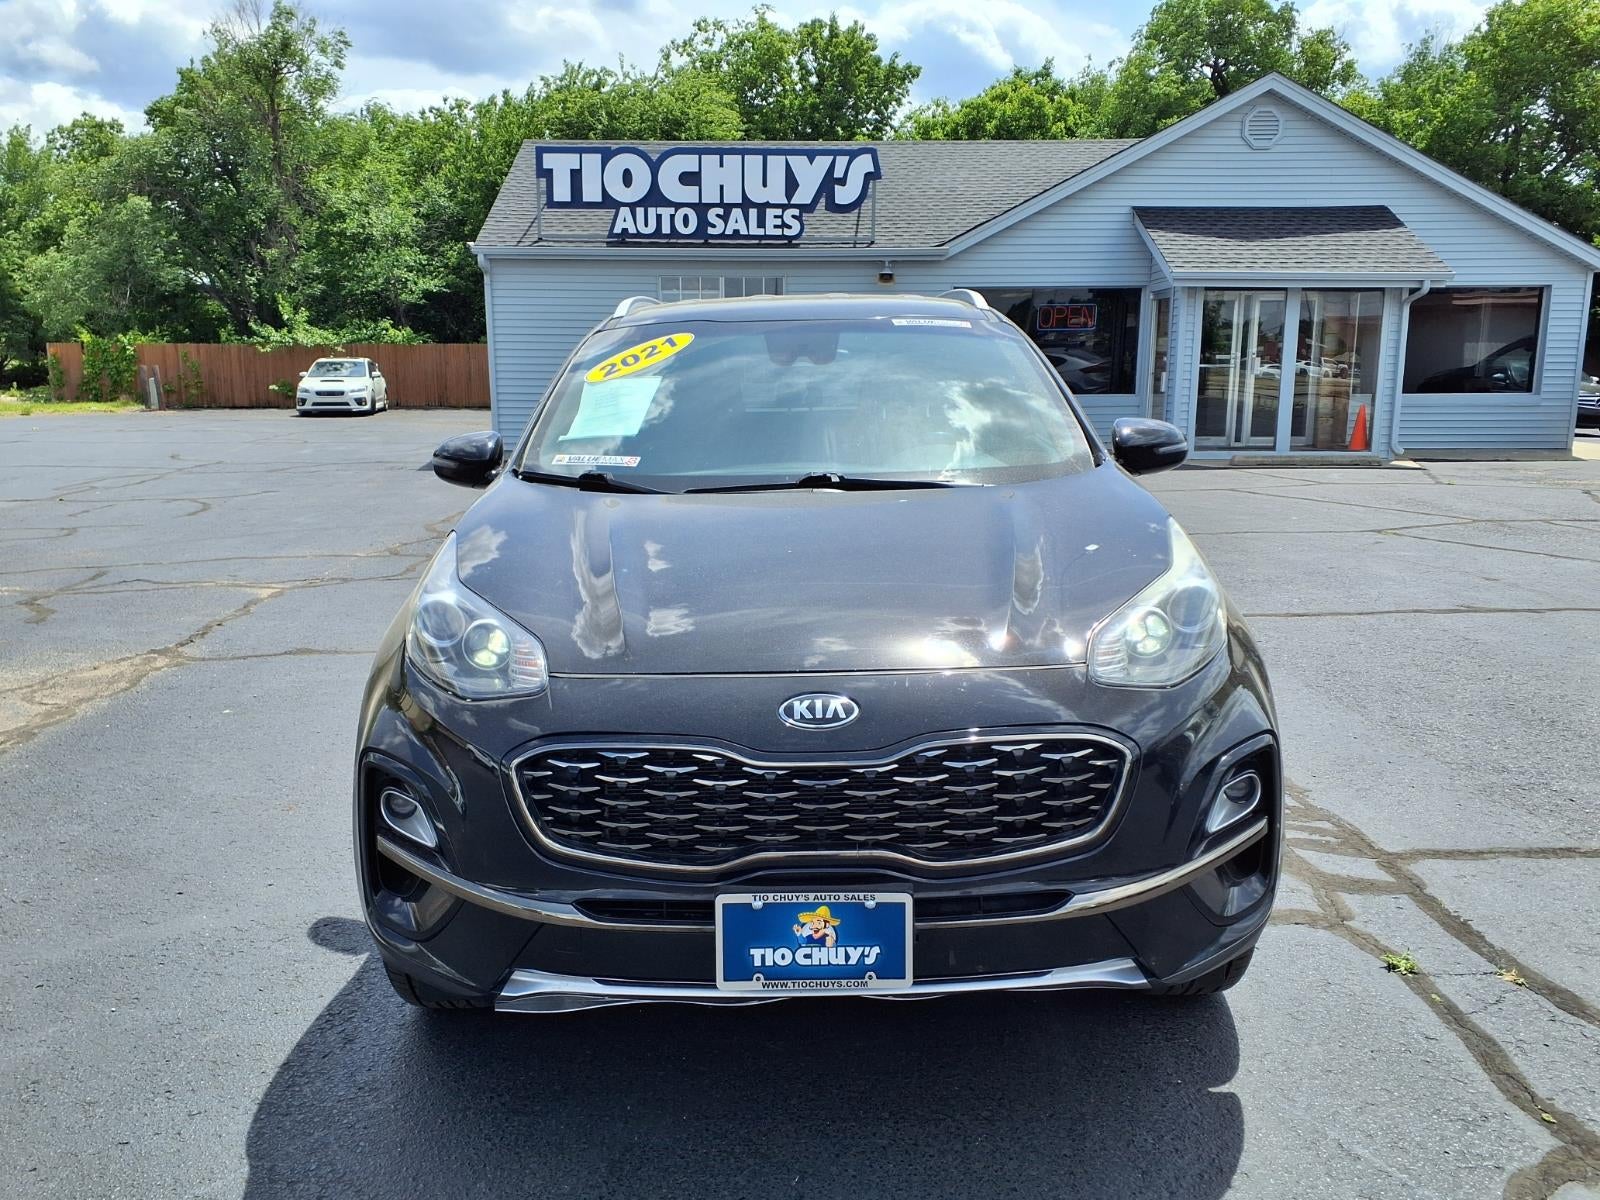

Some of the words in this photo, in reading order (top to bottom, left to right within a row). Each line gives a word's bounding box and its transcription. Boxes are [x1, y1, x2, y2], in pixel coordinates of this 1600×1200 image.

[542, 152, 652, 203] TIO
[657, 152, 875, 205] CHUY'S
[613, 207, 698, 235] AUTO
[706, 208, 801, 236] SALES
[1039, 306, 1095, 328] OPEN
[600, 338, 679, 377] 2021
[793, 699, 847, 720] KIA
[752, 894, 769, 902] TIO
[772, 894, 810, 902] CHUY'S
[813, 894, 841, 902] AUTO
[843, 894, 876, 902] SALES
[750, 948, 793, 967] TIO
[795, 946, 880, 965] CHUY'S
[761, 980, 869, 989] WWW.TIOCHUYS.COM
